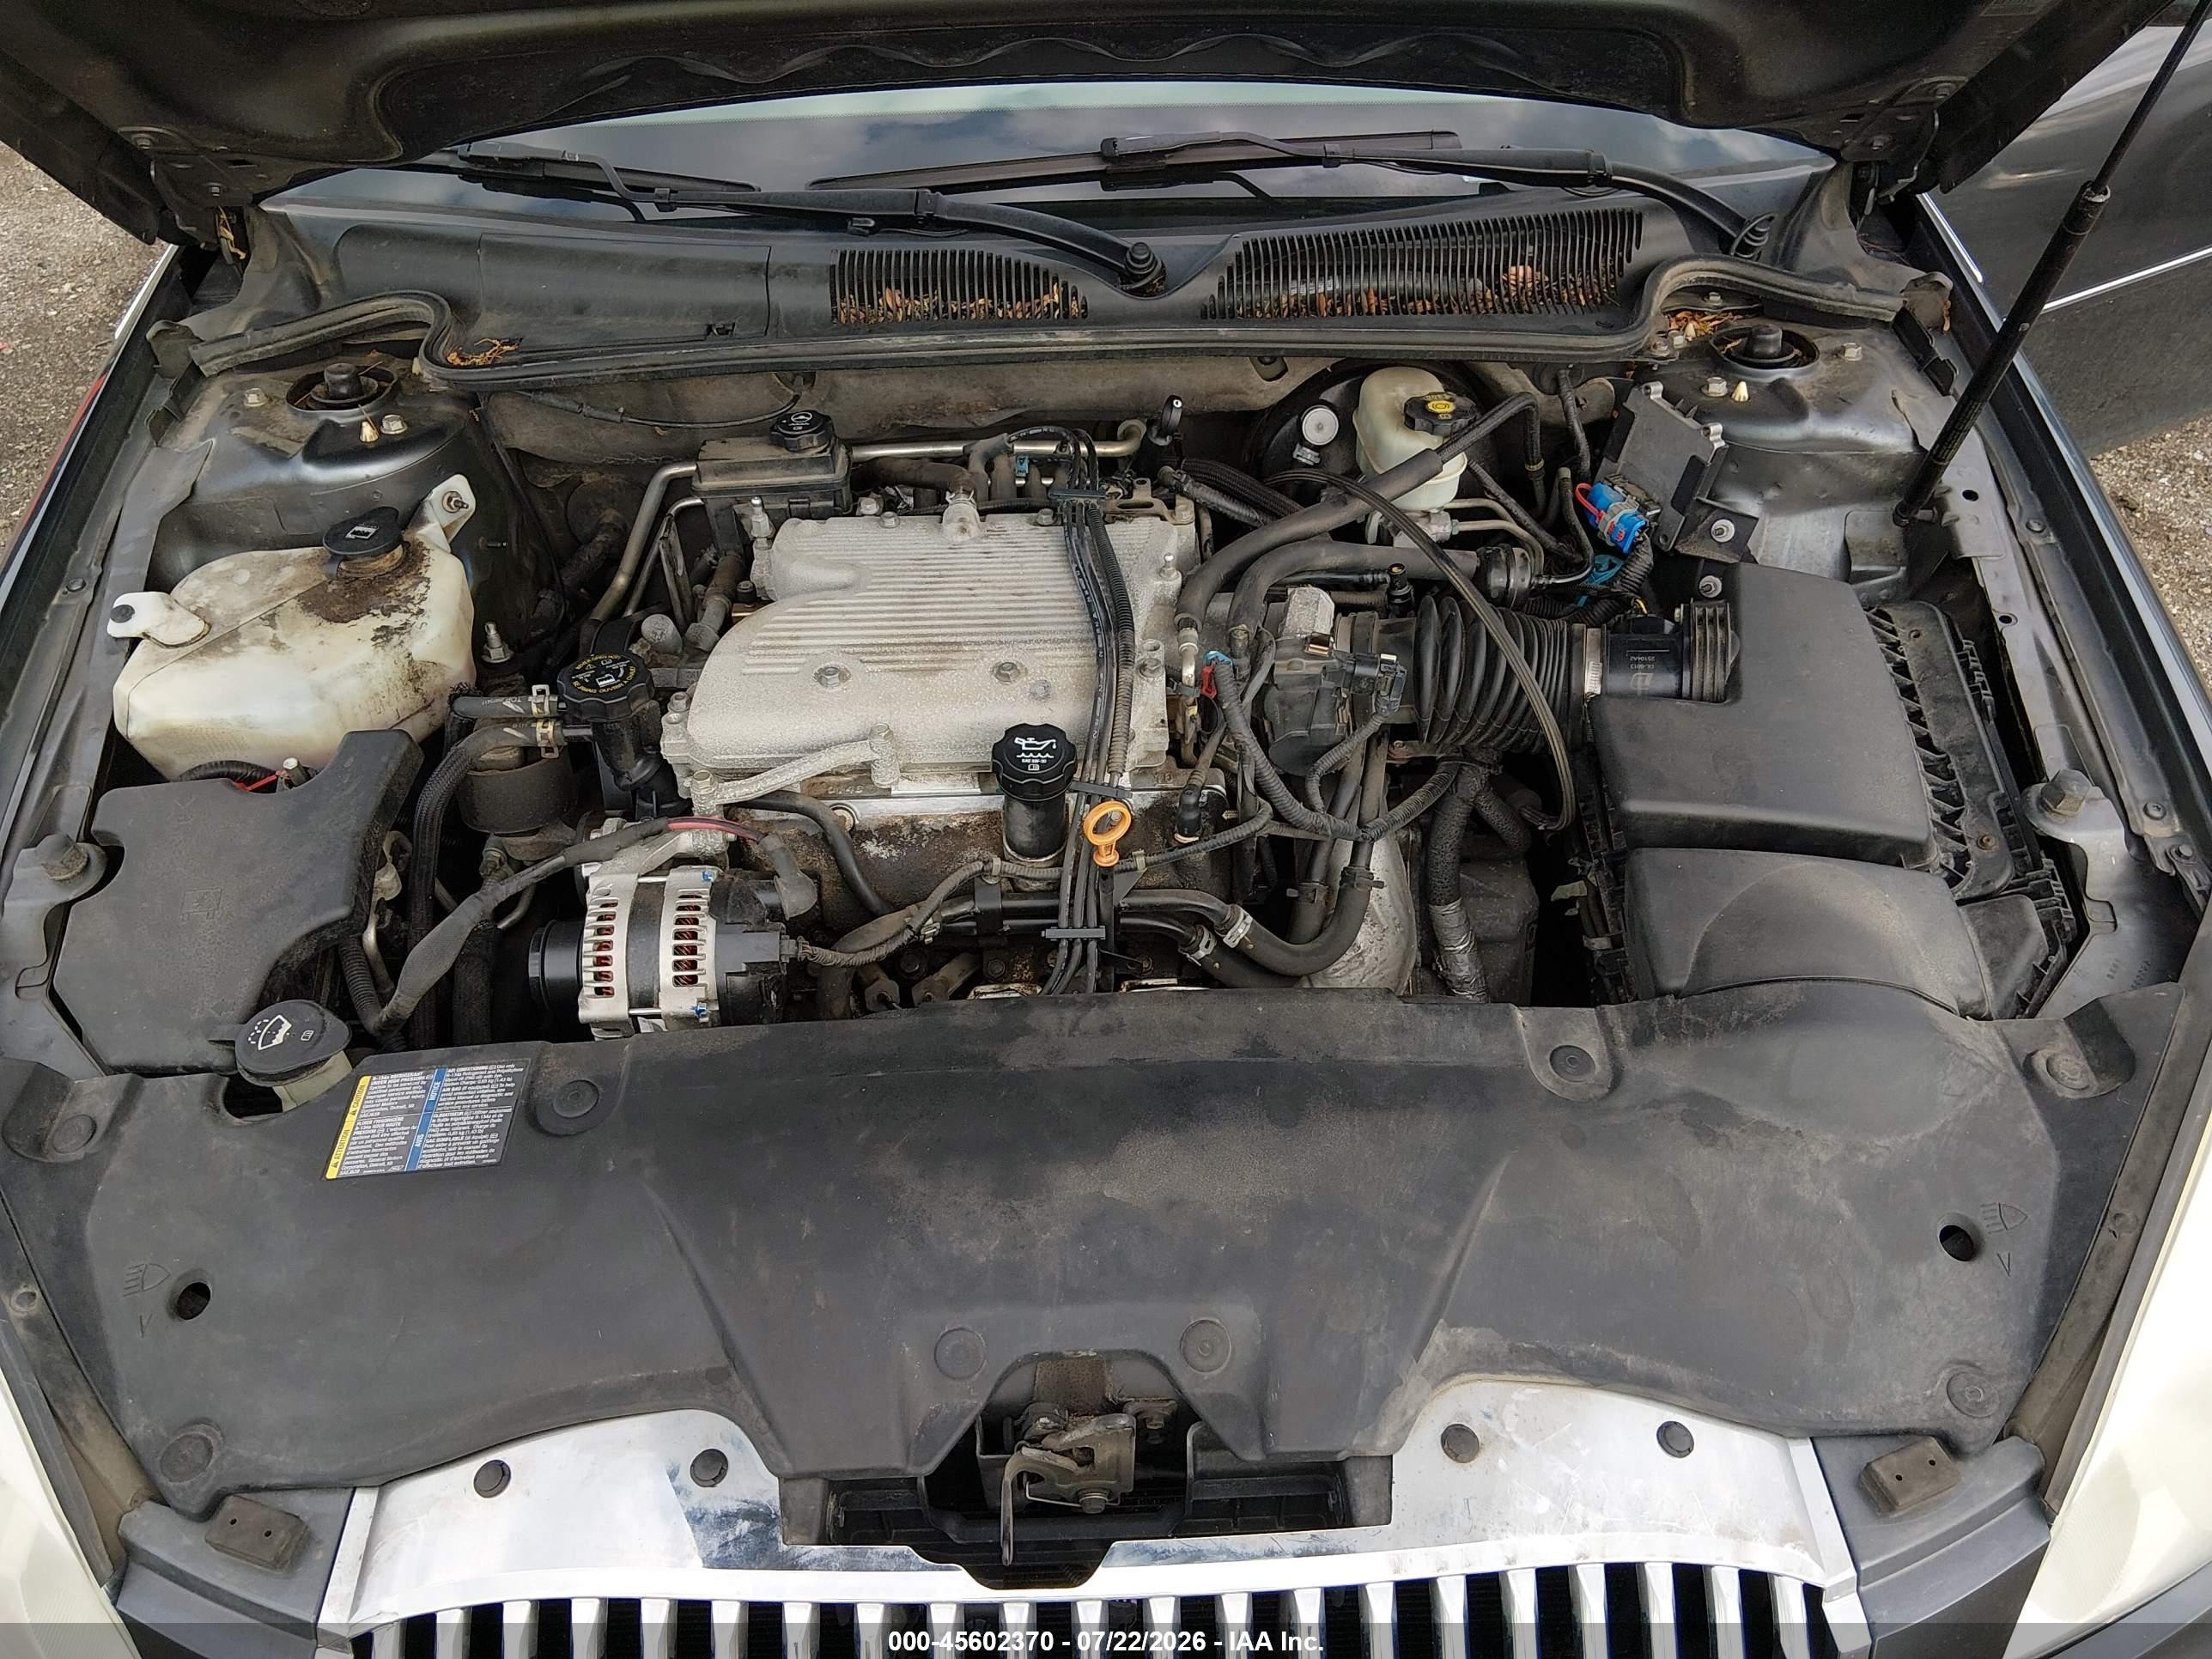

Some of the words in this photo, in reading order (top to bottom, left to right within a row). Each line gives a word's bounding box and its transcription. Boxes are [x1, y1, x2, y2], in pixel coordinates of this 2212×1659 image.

[353, 1085, 365, 1109] CAUTION
[428, 1081, 441, 1101] NOTICE
[334, 1129, 350, 1162] ATTENTION
[415, 1134, 424, 1147] AVIS
